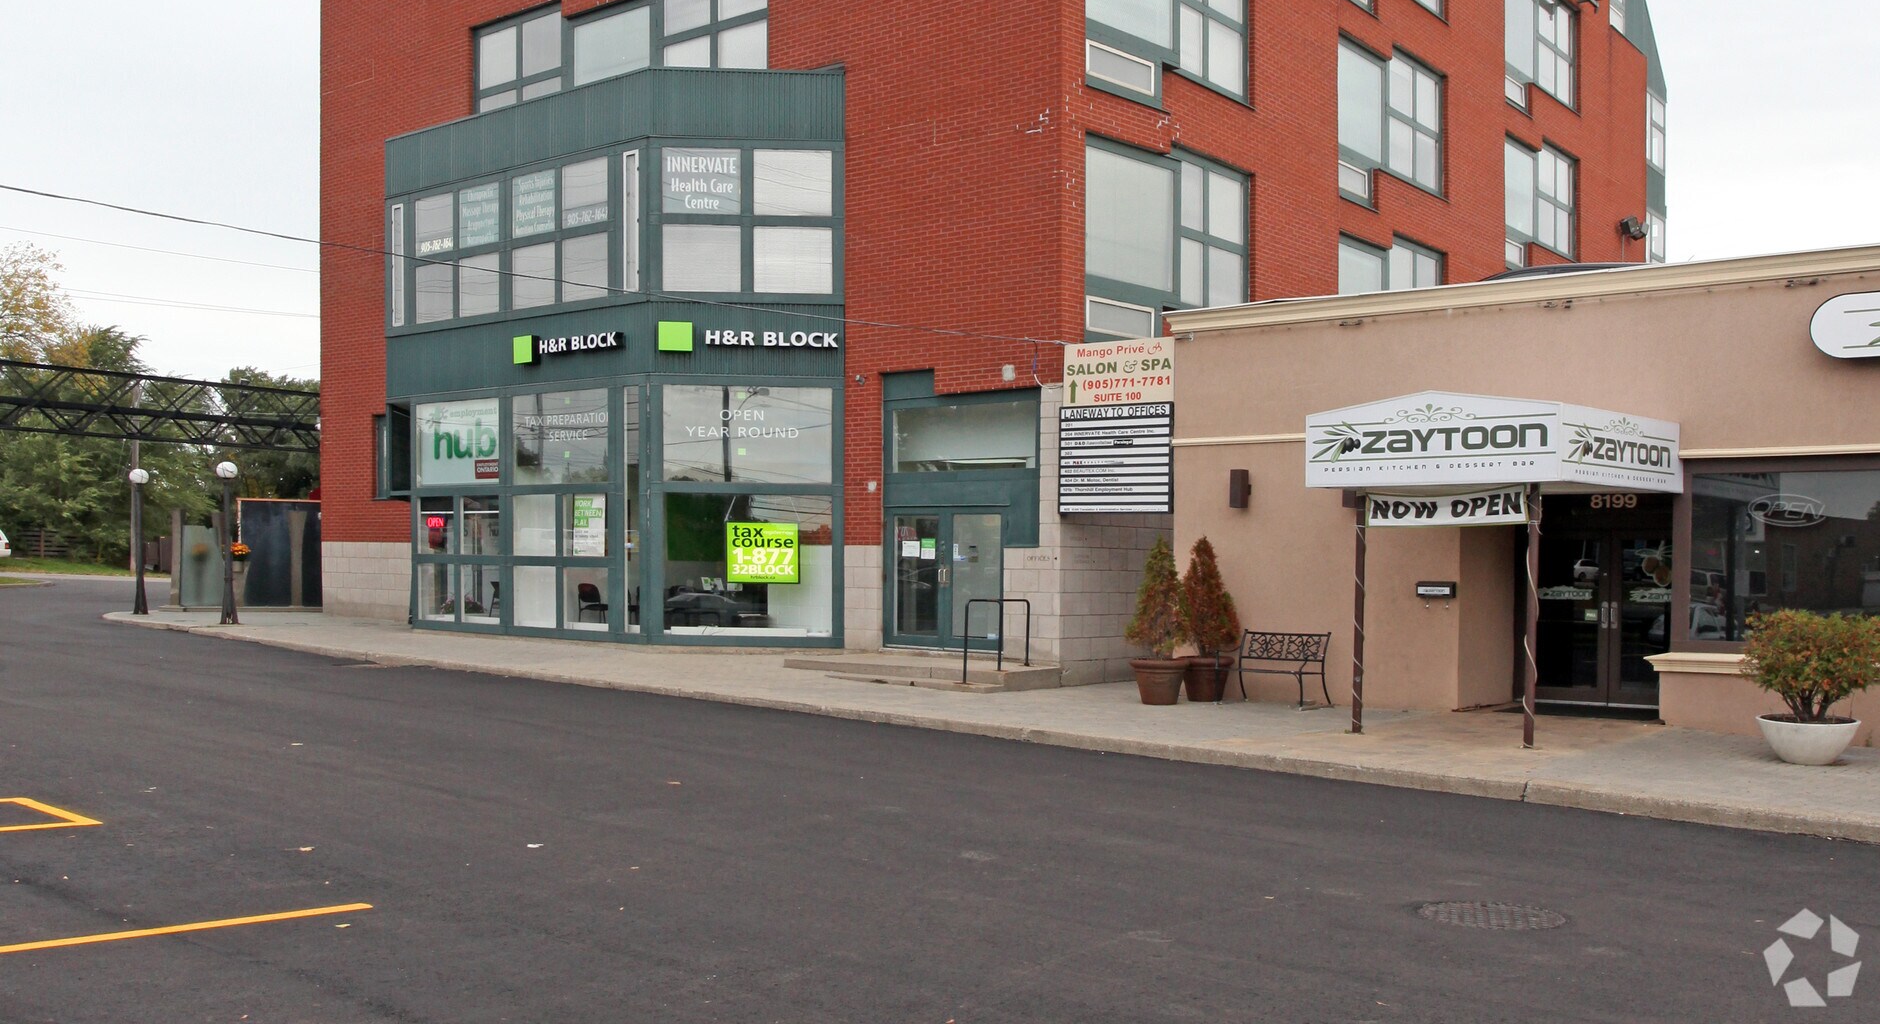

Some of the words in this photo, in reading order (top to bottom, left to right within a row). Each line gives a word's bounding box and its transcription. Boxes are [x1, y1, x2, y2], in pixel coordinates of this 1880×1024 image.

[666, 156, 737, 174] INNERVATE
[671, 177, 707, 192] Health
[710, 178, 734, 193] Care
[684, 194, 720, 209] Centre
[539, 336, 567, 354] H&R
[571, 331, 617, 351] BLOCK
[705, 329, 755, 347] H&R
[763, 331, 839, 348] BLOCK
[1077, 347, 1113, 358] Mango
[1116, 342, 1145, 355] Privé
[1066, 361, 1118, 376] SALON
[1123, 360, 1138, 374] &
[1141, 357, 1172, 372] SPA
[1082, 375, 1171, 391] (905)771-7781
[1094, 392, 1122, 403] SUITE
[1126, 391, 1142, 401] 100
[449, 407, 497, 419] employment
[524, 416, 544, 427] TAX
[546, 411, 608, 426] PREPARATIO
[720, 409, 765, 421] OPEN
[1064, 407, 1109, 419] LANEWAY
[1112, 406, 1124, 417] TO
[1127, 404, 1167, 417] OFFICES
[433, 415, 497, 461] hub
[548, 429, 588, 442] SERVICE
[685, 425, 730, 438] YEAR
[738, 426, 799, 439] ROUND
[1449, 461, 1503, 469] DESSERT
[1371, 499, 1438, 520] NOW
[1451, 491, 1523, 517] OPEN
[1590, 494, 1638, 509] 8199
[1751, 500, 1826, 520] OPEN
[427, 517, 445, 528] OPEN
[732, 525, 764, 538] tax
[732, 537, 794, 548] course
[732, 547, 794, 565] 1-877
[732, 564, 795, 575] 32BLOCK
